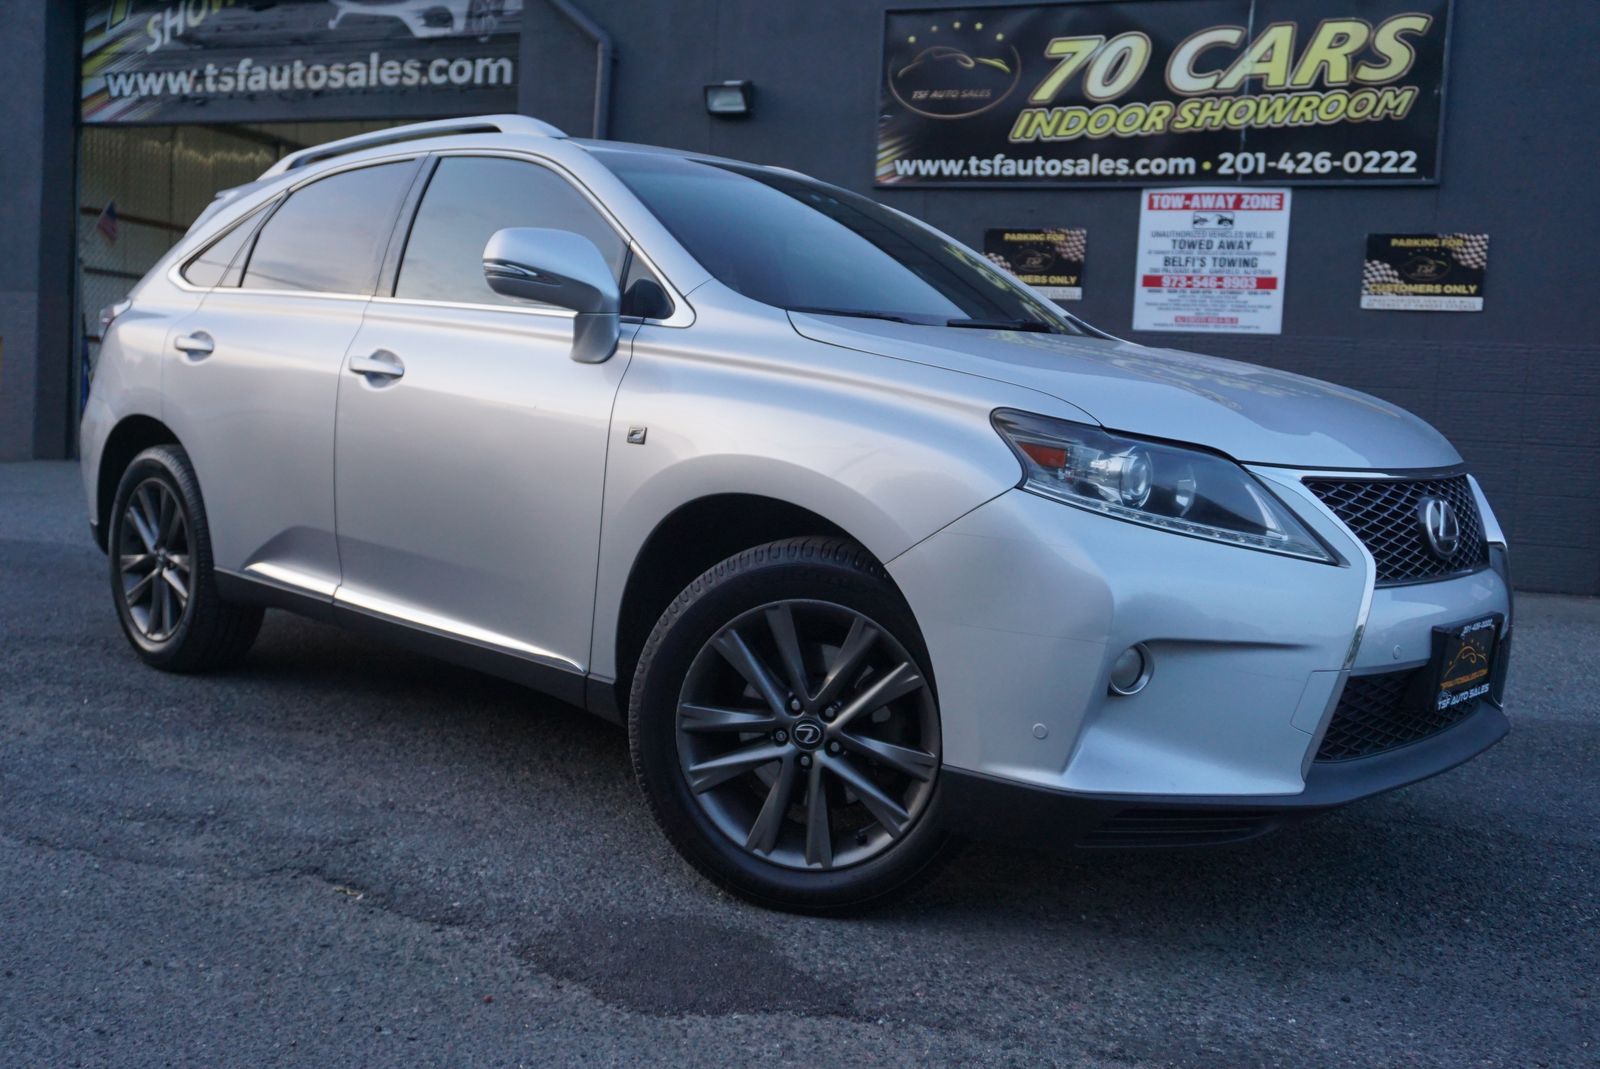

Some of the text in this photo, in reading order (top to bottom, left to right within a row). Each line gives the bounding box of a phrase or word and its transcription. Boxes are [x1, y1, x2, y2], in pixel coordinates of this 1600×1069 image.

[146, 0, 236, 54] SHO
[1030, 15, 1430, 102] 70 CARS
[106, 54, 513, 97] www.tsfautosales.com
[930, 89, 959, 98] AUTO
[961, 88, 992, 97] SALES
[1008, 87, 1419, 143] INDOOR SHOWROOM
[894, 150, 1418, 177] www.tsfautosales.com 201-426-0222
[1151, 194, 1281, 209] TOW-AWAY ZONE
[1004, 233, 1045, 241] PARKING
[1391, 238, 1439, 247] PARKING
[1171, 239, 1253, 250] TOWED AWAY
[1163, 256, 1258, 268] BELFI'S TOWING
[1049, 275, 1077, 285] ONLY
[1368, 283, 1477, 294] CUSTOMERS ONLY
